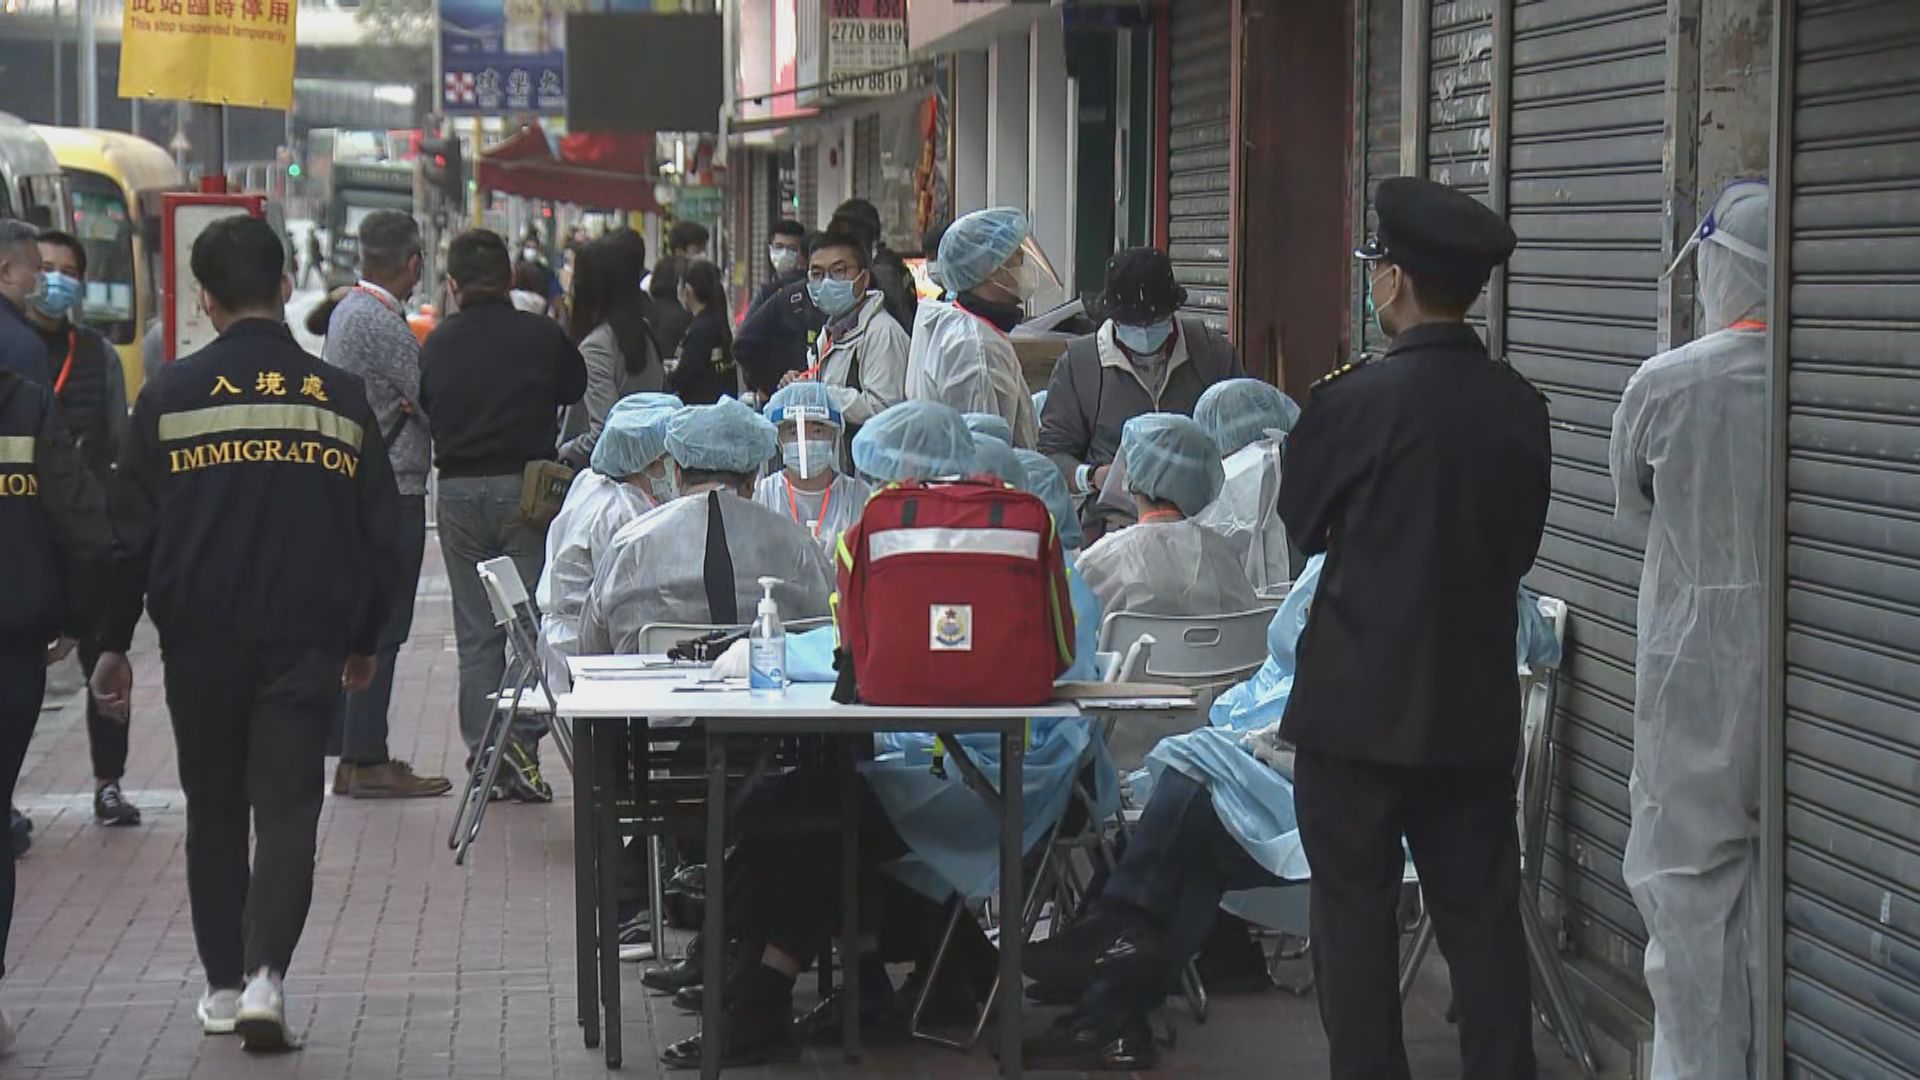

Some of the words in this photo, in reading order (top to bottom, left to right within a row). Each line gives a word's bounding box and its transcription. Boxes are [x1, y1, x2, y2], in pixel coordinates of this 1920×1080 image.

[131, 17, 151, 31] This
[154, 20, 176, 34] stop
[179, 22, 231, 37] suspended
[232, 25, 287, 46] temporarily
[831, 22, 865, 41] 2770
[869, 22, 902, 41] 8819
[869, 71, 902, 90] 8819
[209, 371, 329, 402] 入境處
[169, 439, 359, 479] IMMIGRATON
